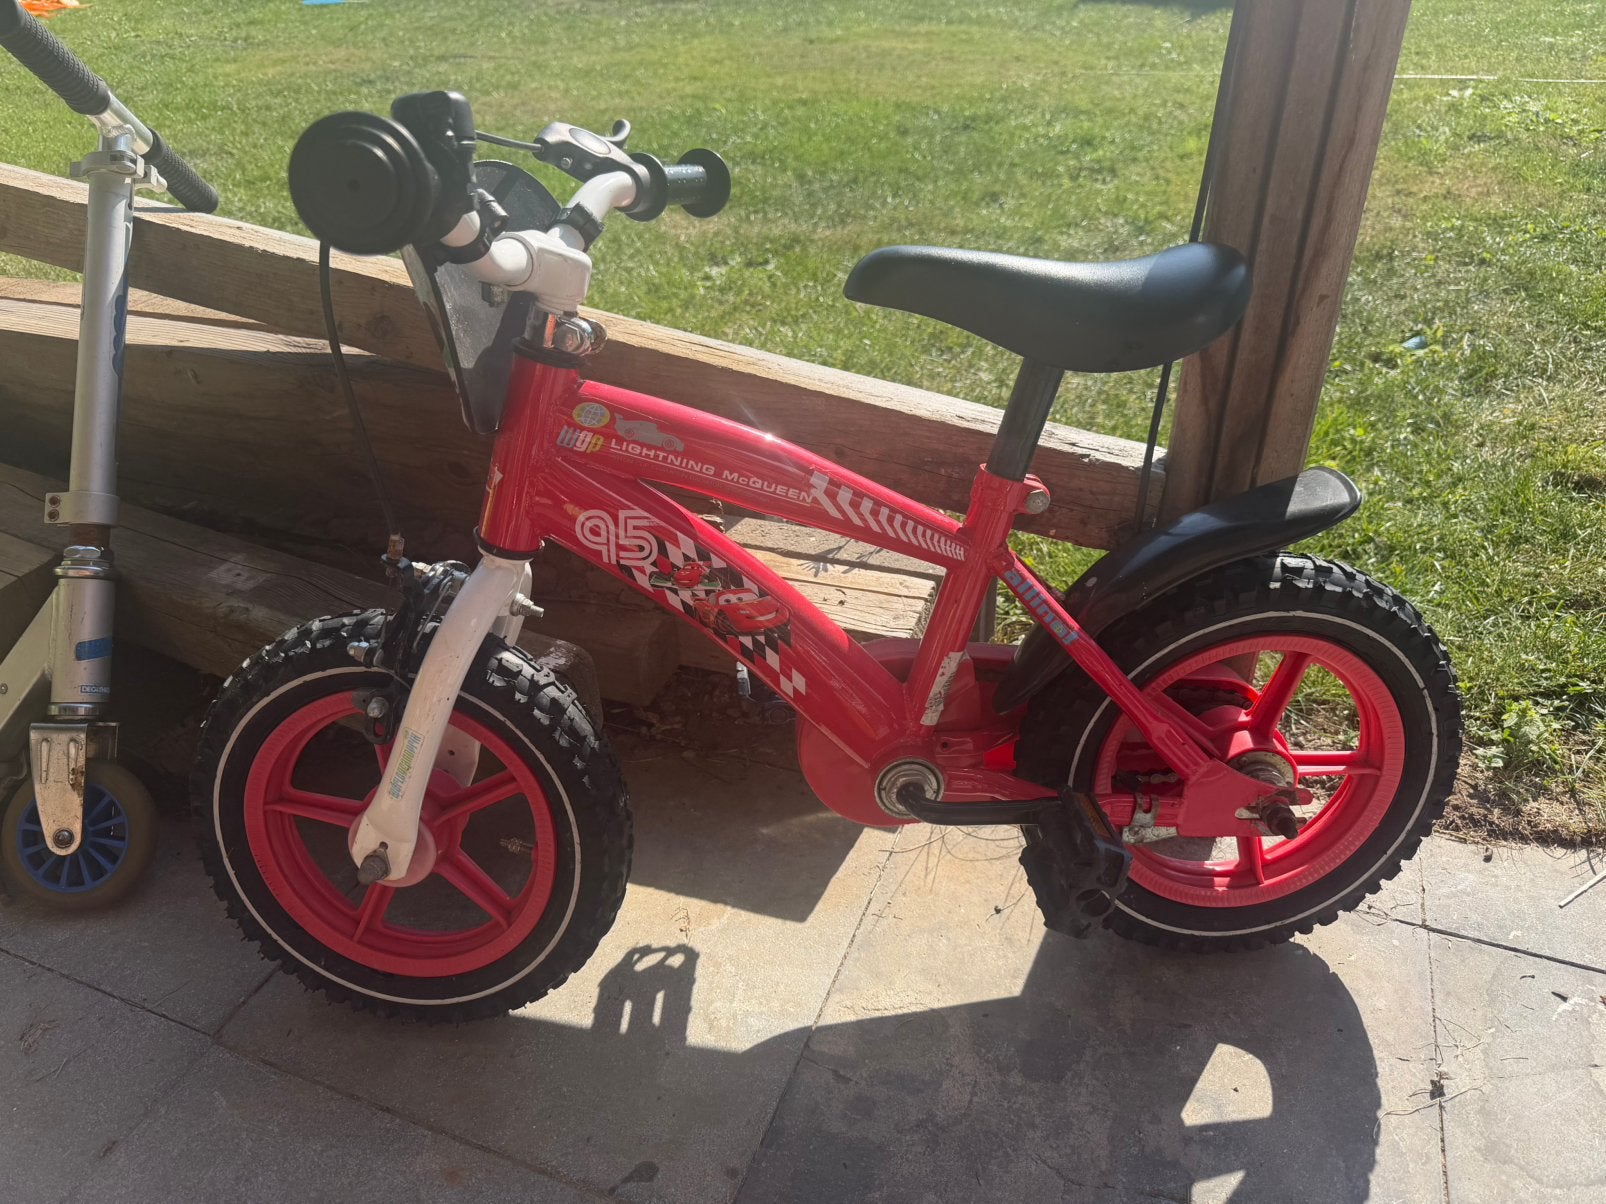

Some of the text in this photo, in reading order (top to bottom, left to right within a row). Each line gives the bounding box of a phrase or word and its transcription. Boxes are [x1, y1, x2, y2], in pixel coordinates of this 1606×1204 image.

[610, 438, 715, 475] LIGHTNING
[721, 470, 813, 503] McQUEEN
[575, 509, 659, 566] 95
